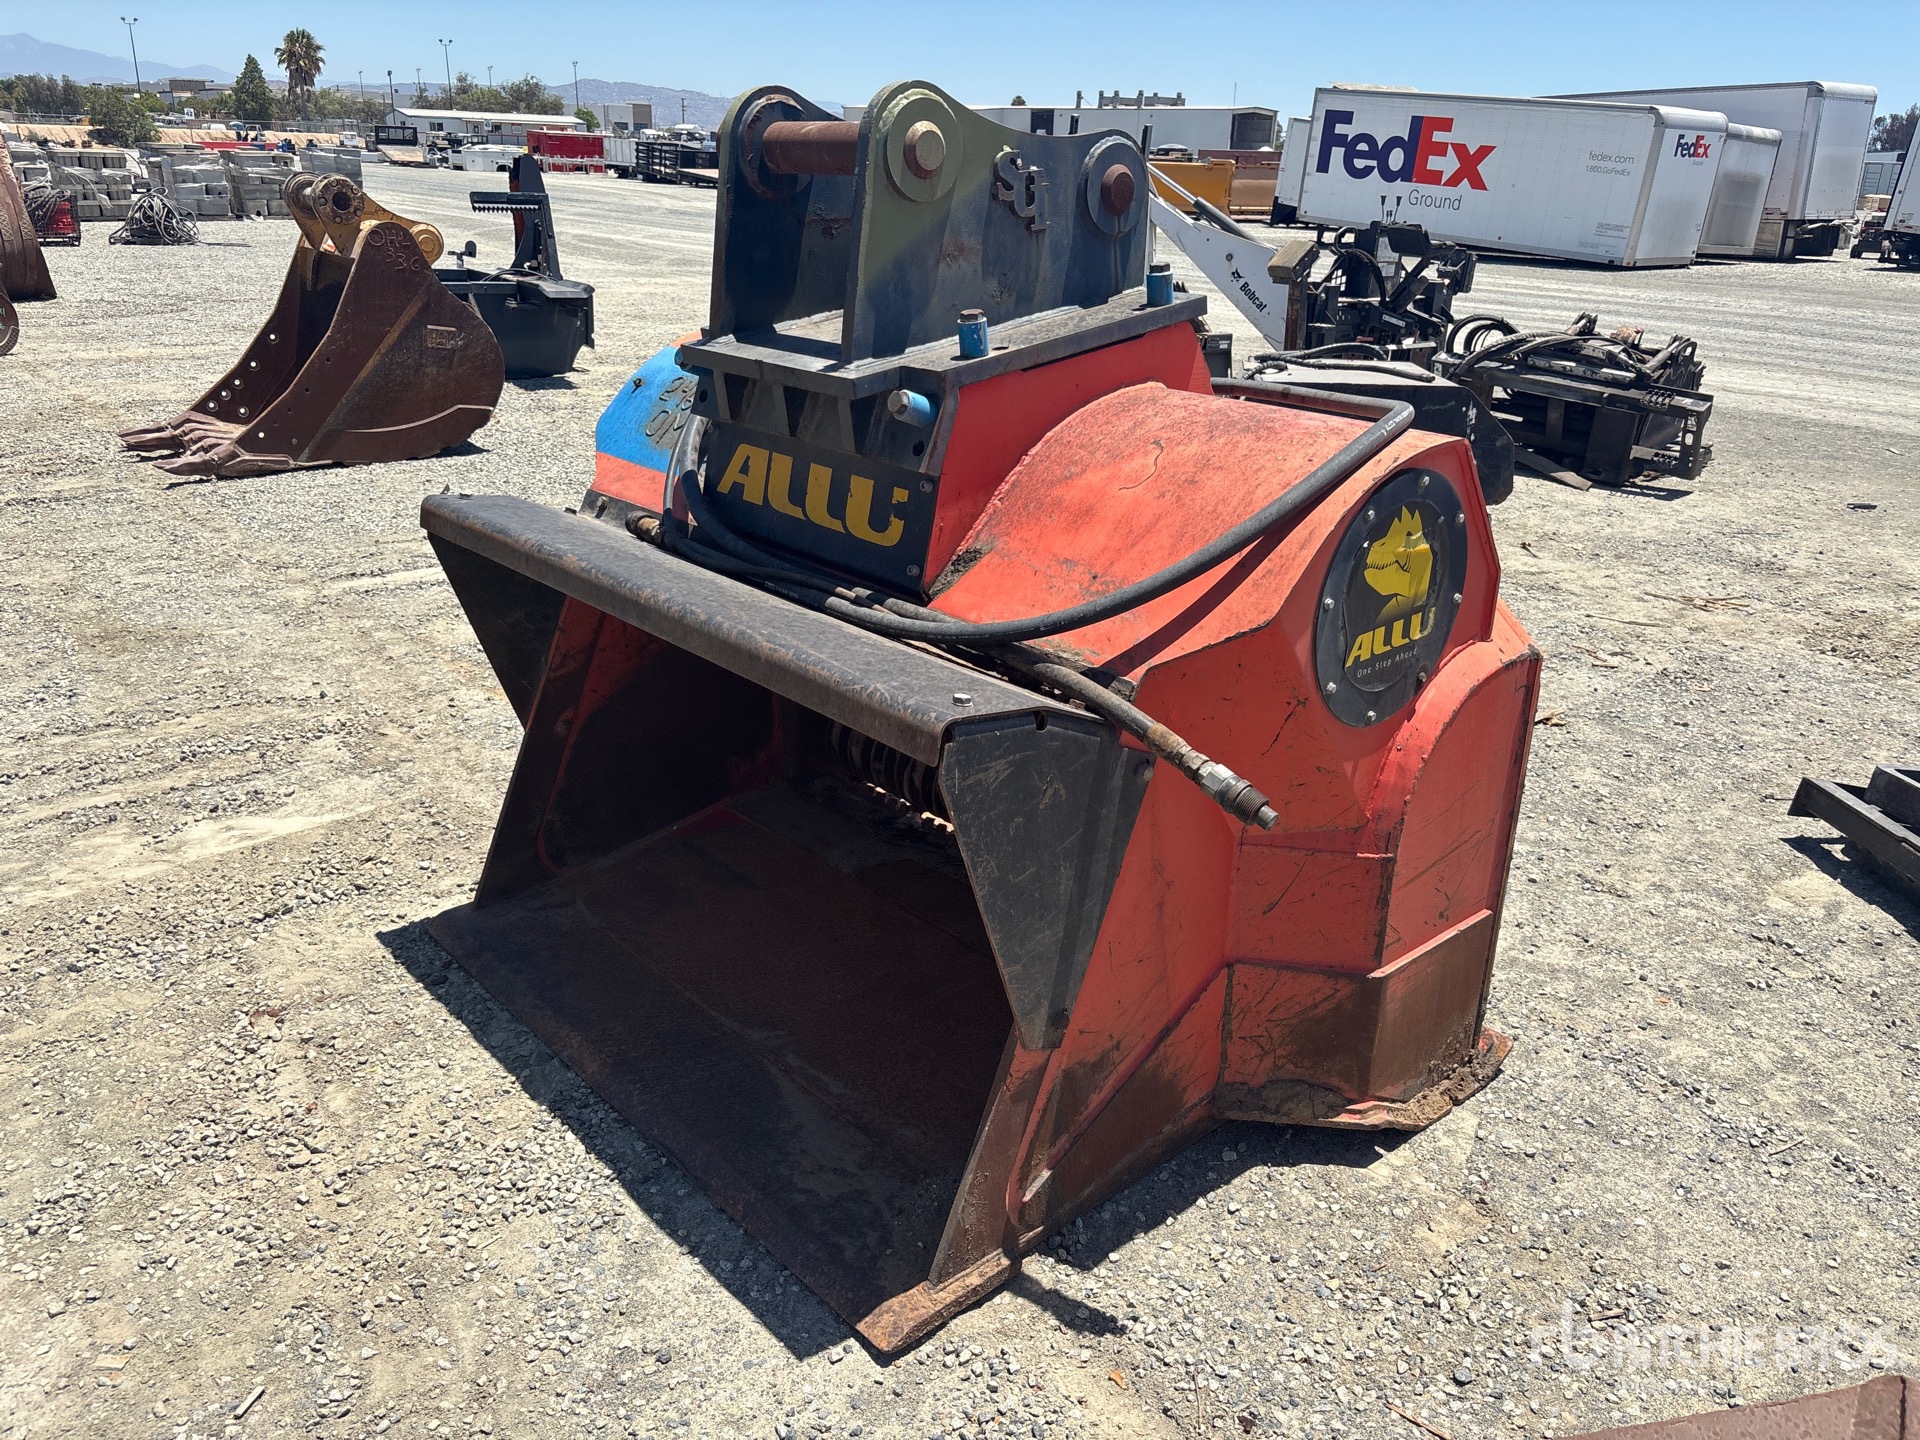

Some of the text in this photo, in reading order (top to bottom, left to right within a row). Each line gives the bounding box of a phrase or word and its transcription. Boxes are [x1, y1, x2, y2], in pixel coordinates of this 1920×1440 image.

[1316, 109, 1498, 191] FedEx
[1588, 150, 1635, 164] fedex.com
[1674, 133, 1712, 158] FedEx
[1408, 189, 1463, 211] Ground
[1239, 281, 1268, 313] Bobcat
[716, 442, 910, 547] ALLU
[1346, 606, 1437, 668] ALLU
[1357, 646, 1418, 678] One Step Ahead
